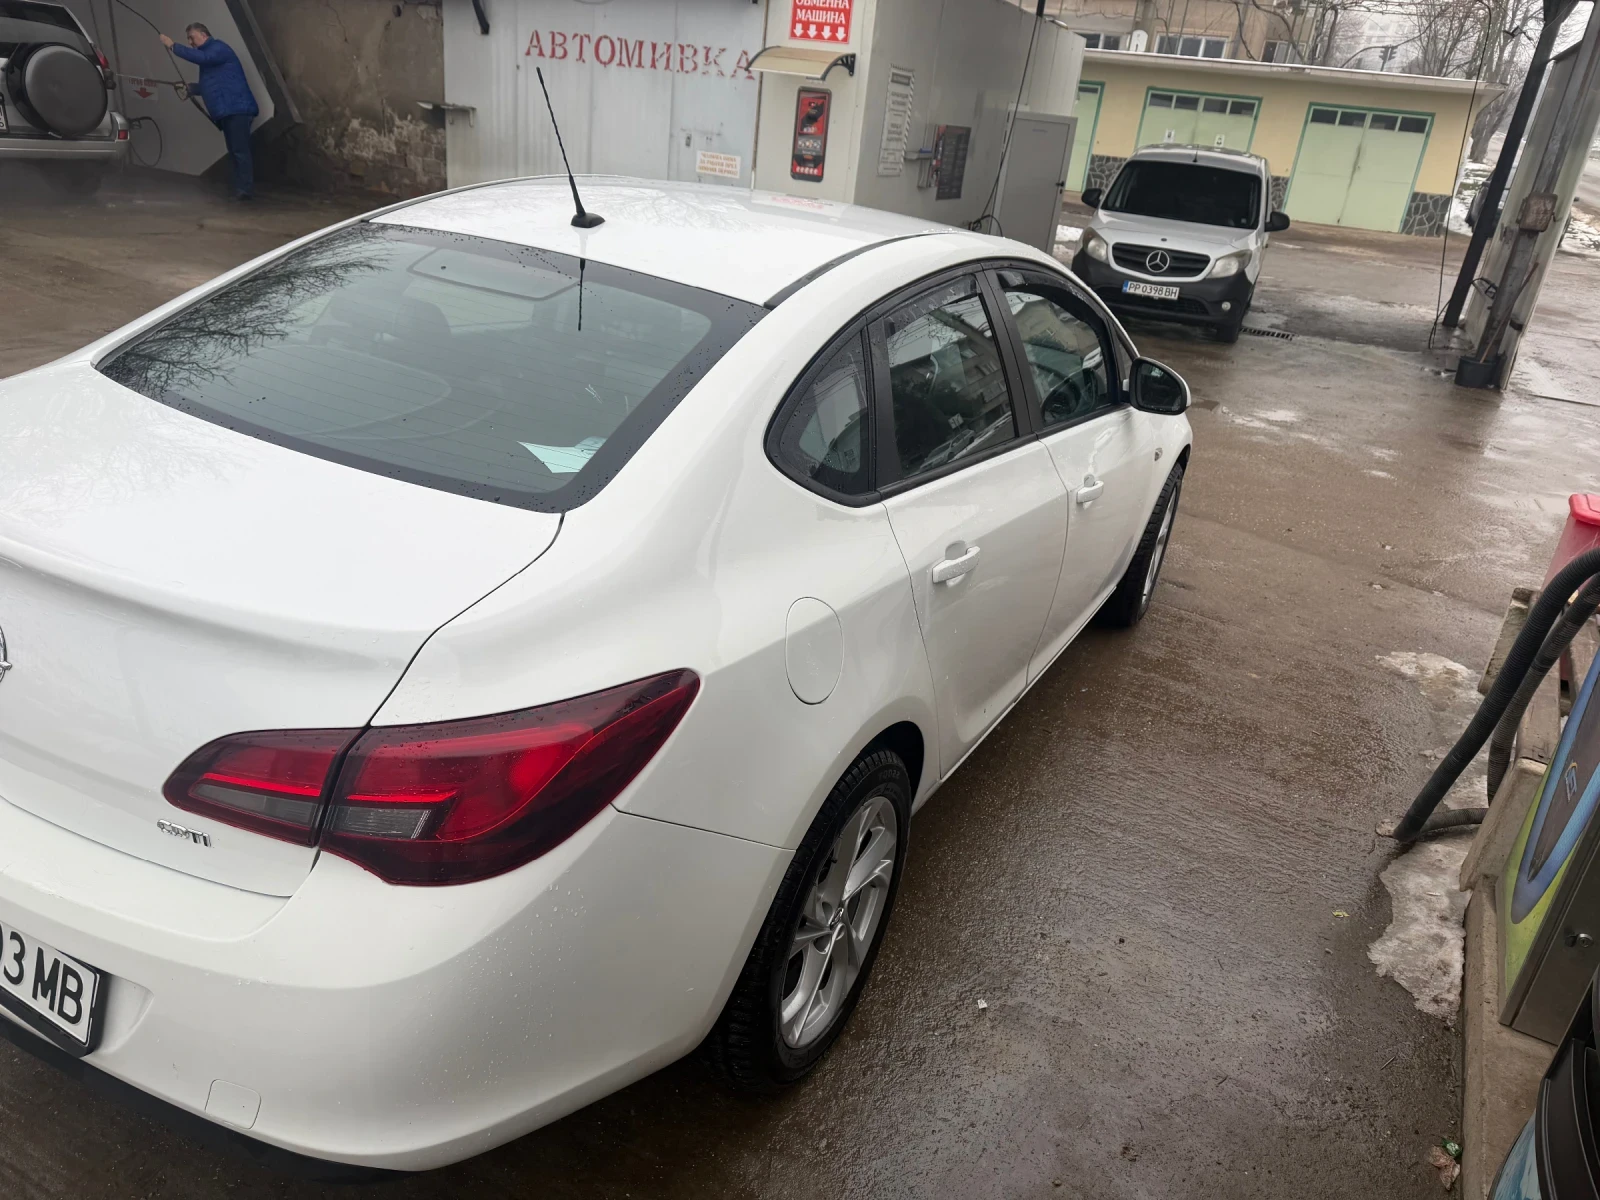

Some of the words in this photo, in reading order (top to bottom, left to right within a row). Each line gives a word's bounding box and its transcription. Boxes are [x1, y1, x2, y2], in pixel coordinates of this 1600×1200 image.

[795, 8, 846, 25] МАШИНА
[525, 29, 756, 80] АВТОМИВКА
[1141, 285, 1164, 296] 0398
[31, 946, 84, 1024] MB
